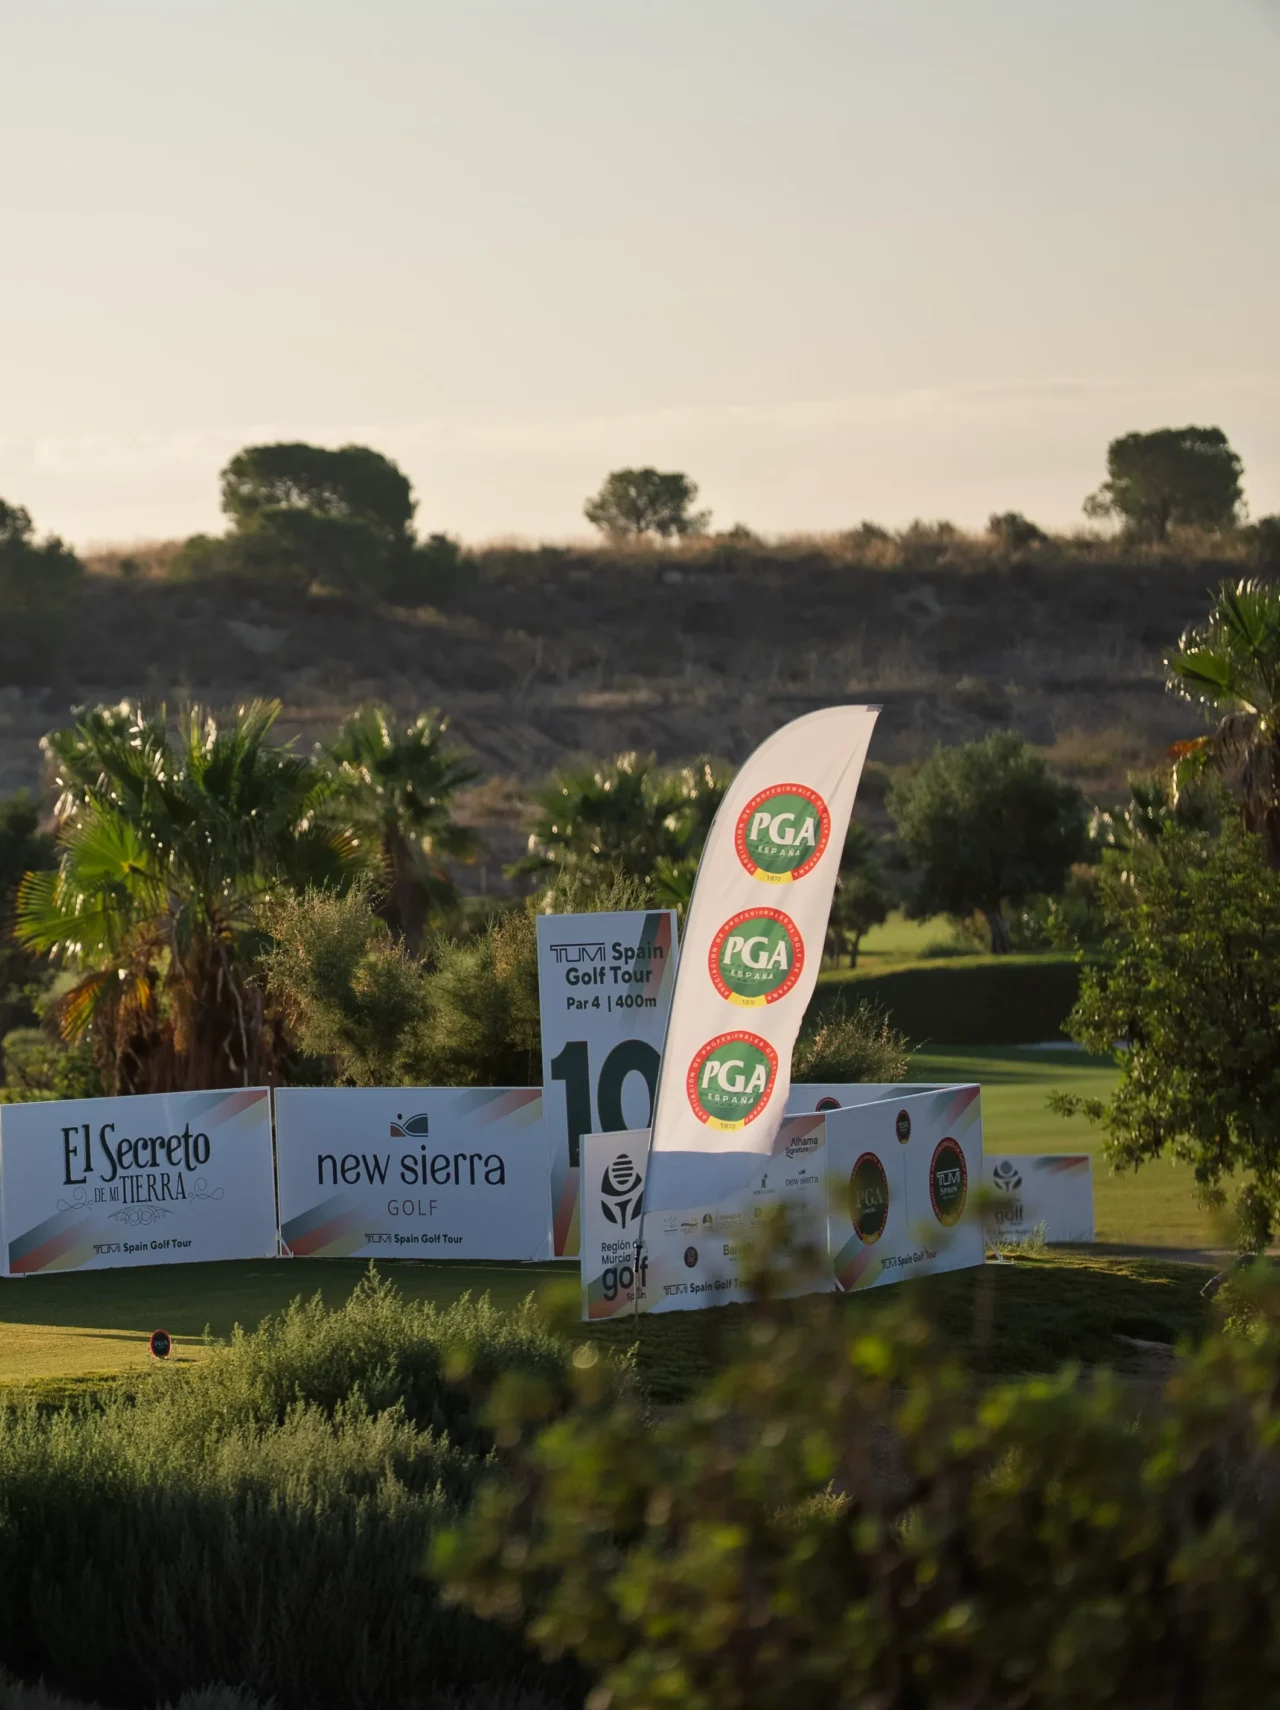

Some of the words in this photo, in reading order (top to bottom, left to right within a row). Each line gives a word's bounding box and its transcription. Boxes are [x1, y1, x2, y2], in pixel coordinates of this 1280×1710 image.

[749, 812, 816, 846] PGA
[758, 845, 800, 856] ESPAÑA
[550, 943, 606, 963] TUMI
[611, 942, 664, 965] Spain
[723, 936, 788, 970] PGA
[565, 966, 606, 986] Golf
[609, 966, 652, 985] Tour
[730, 969, 774, 980] ESPAÑA
[567, 996, 589, 1010] Par
[591, 995, 601, 1009] 4
[615, 994, 657, 1008] 400m
[701, 1059, 767, 1094] PGA
[550, 1039, 661, 1167] 10
[707, 1093, 754, 1104] ESPAÑA
[790, 1137, 818, 1147] Alhama
[61, 1123, 94, 1185] El
[99, 1122, 211, 1183] Secreto
[317, 1154, 391, 1185] new
[400, 1144, 506, 1185] sierra
[94, 1187, 108, 1203] DE
[109, 1186, 120, 1202] MI
[119, 1171, 187, 1204] TIERRA
[387, 1199, 438, 1216] GOLF
[93, 1242, 121, 1254] TUMI
[123, 1241, 148, 1254] Spain
[150, 1239, 170, 1250] Golf
[171, 1238, 192, 1248] Tour
[364, 1233, 392, 1244] TUMI
[394, 1233, 419, 1245] Spain
[421, 1234, 441, 1244] Golf
[442, 1234, 463, 1244] Tour
[601, 1240, 631, 1254] Región
[601, 1252, 631, 1265] Murcia
[602, 1255, 648, 1302] gof
[690, 1281, 713, 1295] Spain
[714, 1278, 732, 1290] Golf
